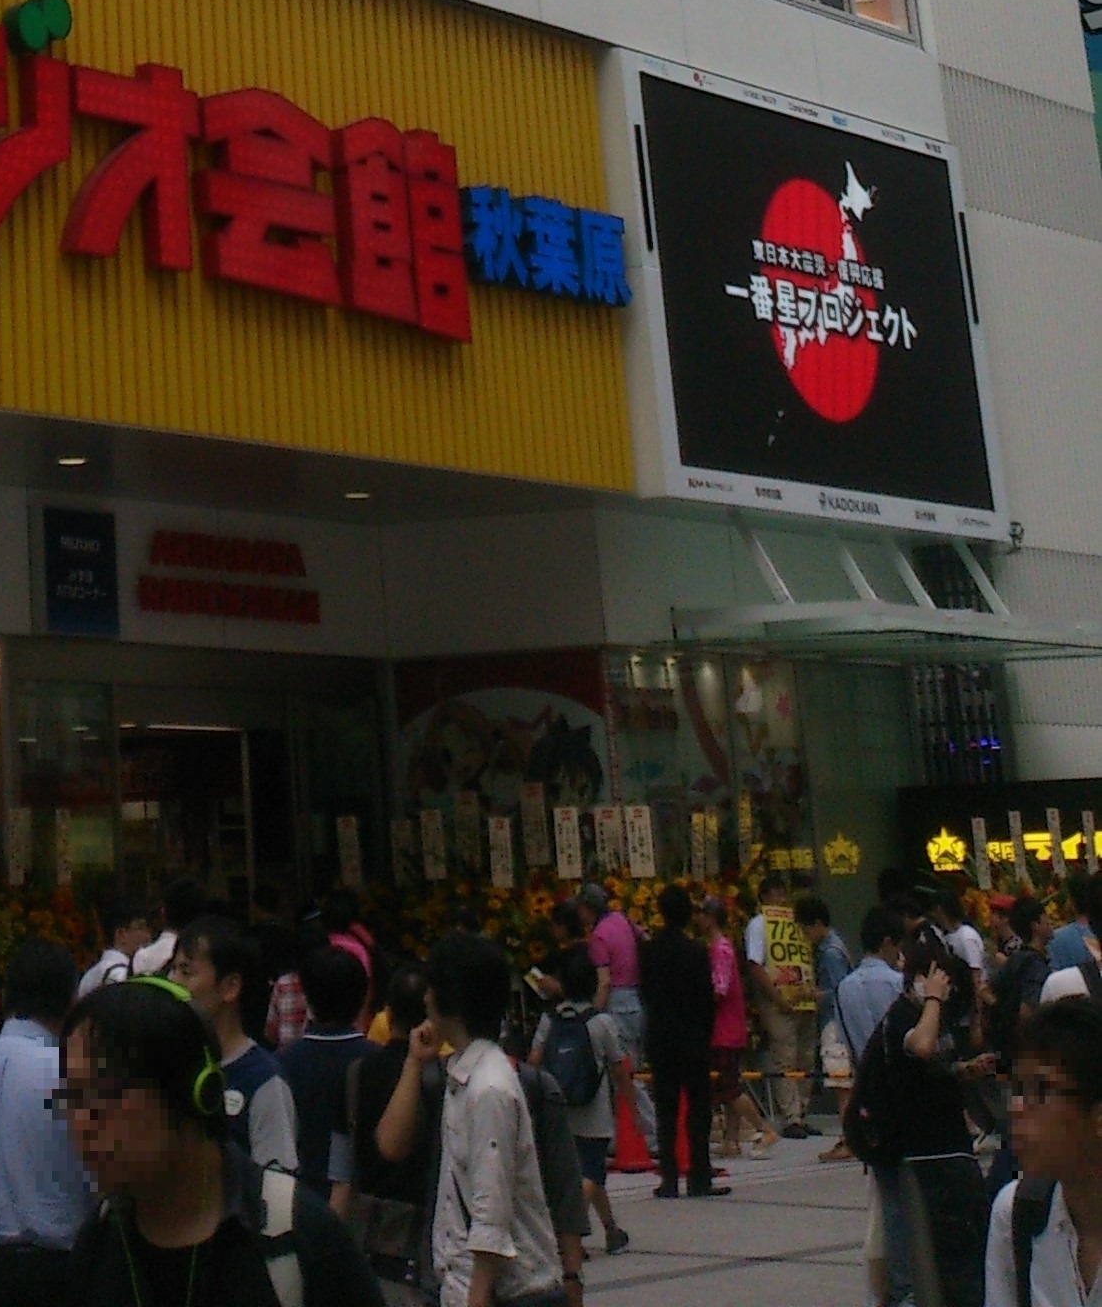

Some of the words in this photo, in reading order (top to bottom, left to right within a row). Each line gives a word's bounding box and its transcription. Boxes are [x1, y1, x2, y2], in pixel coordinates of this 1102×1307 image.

[461, 184, 633, 308] 秋葉原
[725, 273, 918, 351] 一番星プロジェクト
[766, 920, 803, 941] 7/2
[770, 941, 810, 965] OPE
